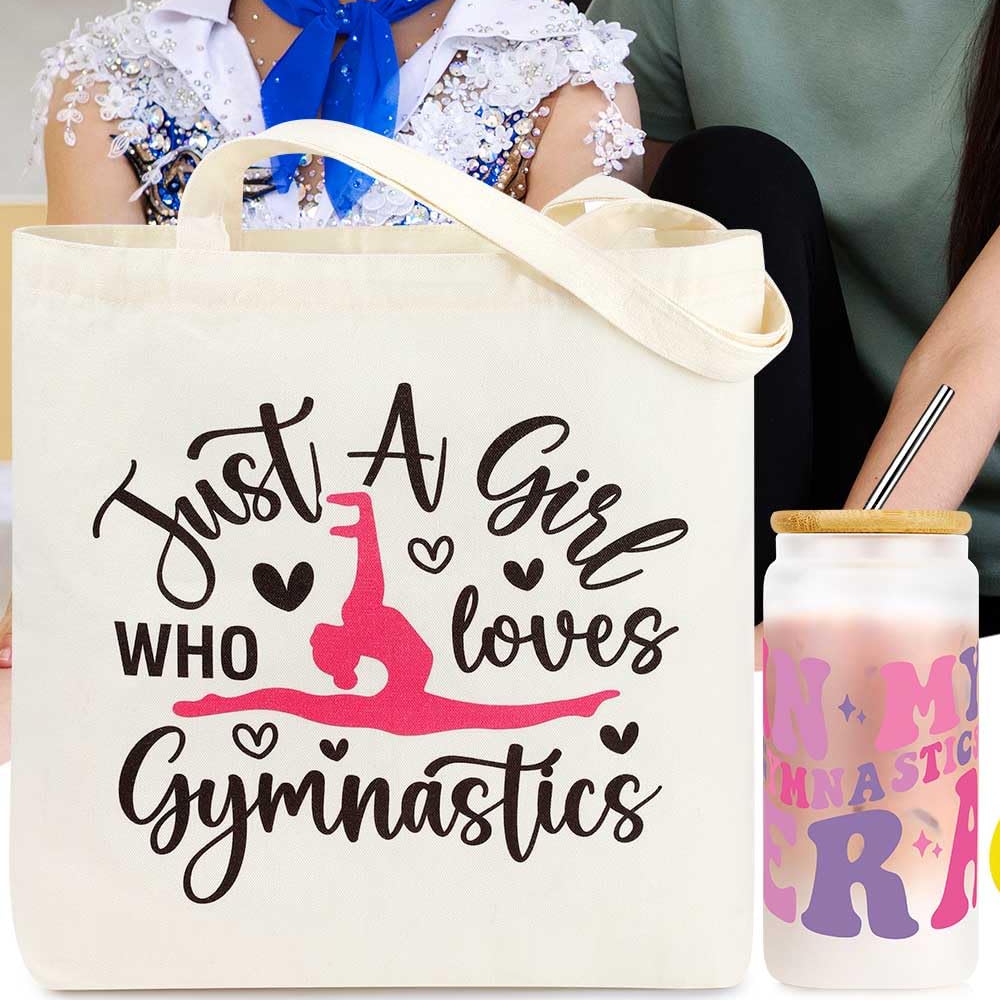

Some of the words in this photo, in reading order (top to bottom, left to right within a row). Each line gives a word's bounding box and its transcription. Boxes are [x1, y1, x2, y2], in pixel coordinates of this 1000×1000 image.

[93, 397, 322, 610] Just
[347, 382, 447, 513] A
[476, 415, 689, 590] Girl
[113, 620, 258, 681] WHO
[451, 585, 679, 675] loves
[763, 637, 831, 761] N
[118, 725, 662, 904] Gymnastics
[763, 730, 979, 810] YMNASTIC
[763, 767, 979, 940] ERA
